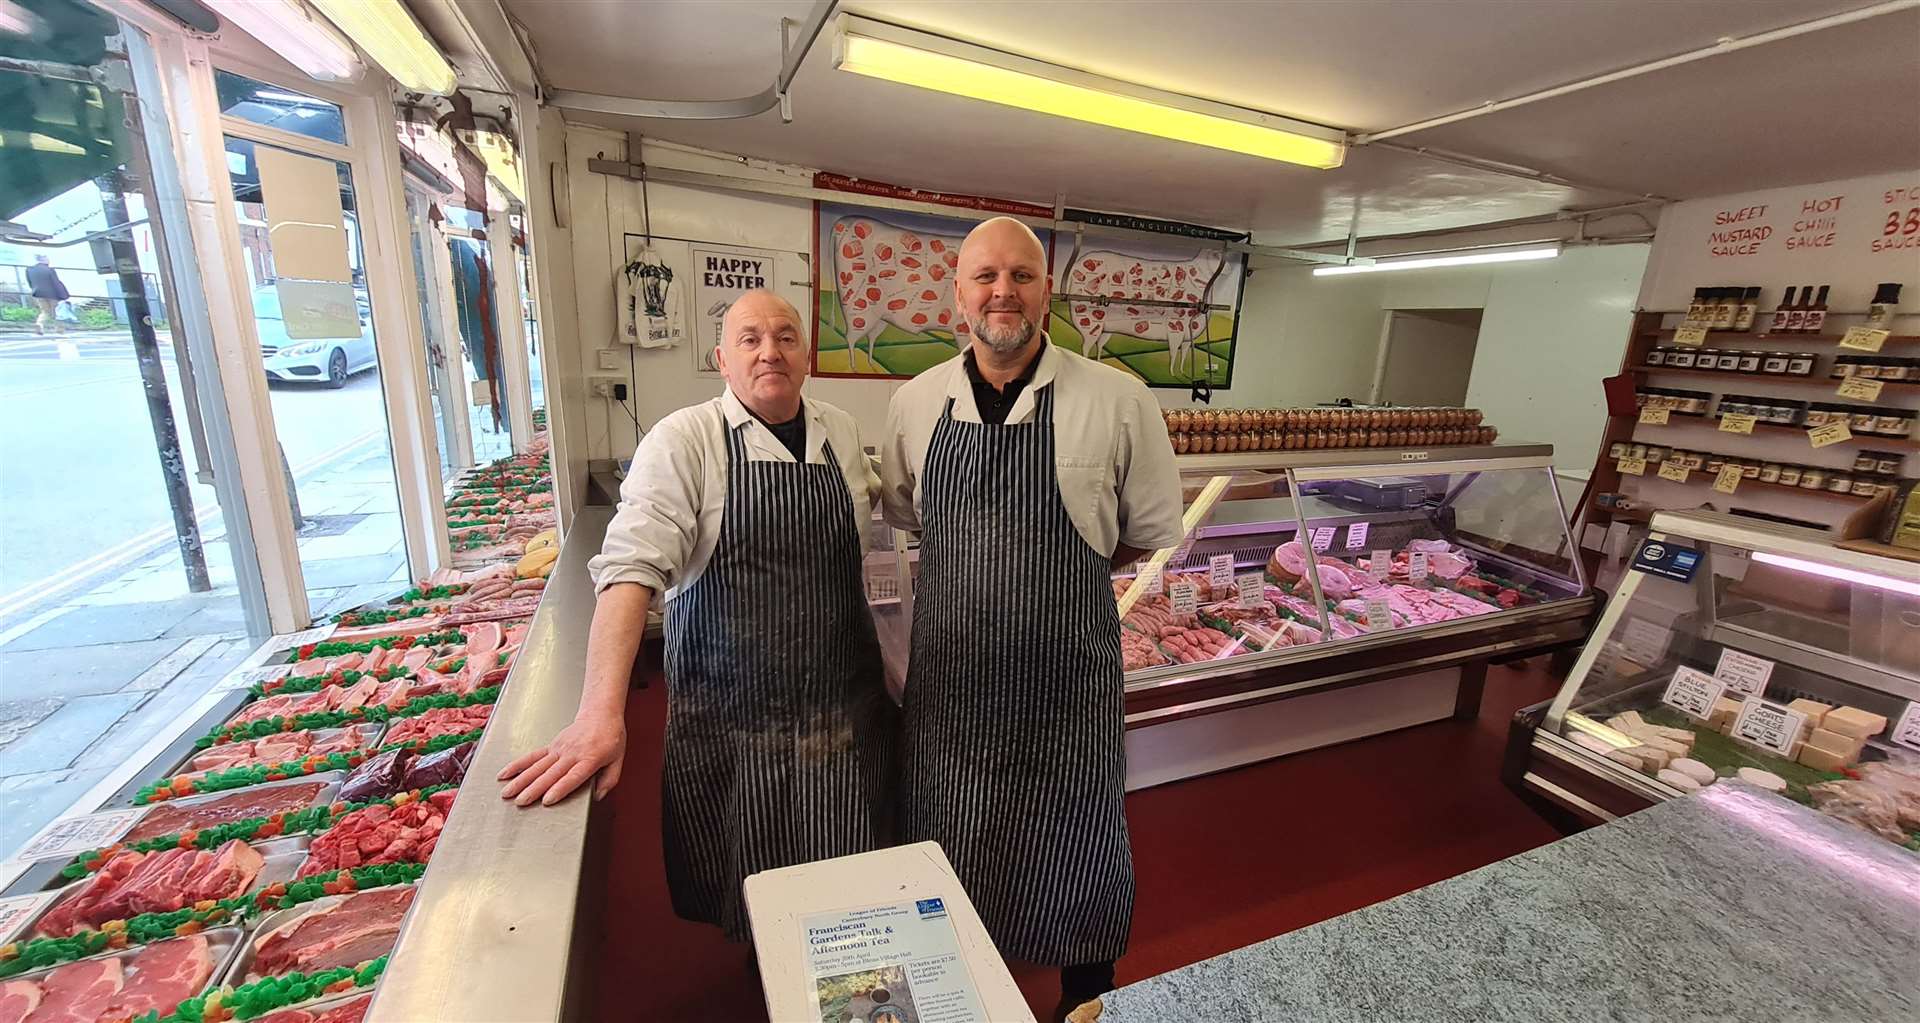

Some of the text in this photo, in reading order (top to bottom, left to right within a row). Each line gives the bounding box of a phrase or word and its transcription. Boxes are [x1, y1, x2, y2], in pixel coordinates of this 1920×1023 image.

[1801, 196, 1844, 214] HOT
[1715, 205, 1769, 226] SWEET
[1707, 226, 1773, 245] MUSTARD
[1786, 233, 1836, 250] SAUCE
[1711, 243, 1761, 257] SAUCE
[706, 256, 762, 275] HAPPY
[704, 272, 765, 289] EASTER
[1749, 713, 1784, 732] CHEESE
[808, 922, 867, 936] Franciscan
[810, 925, 894, 945] Gardens Talk &
[811, 937, 890, 956] Afternoon Tea
